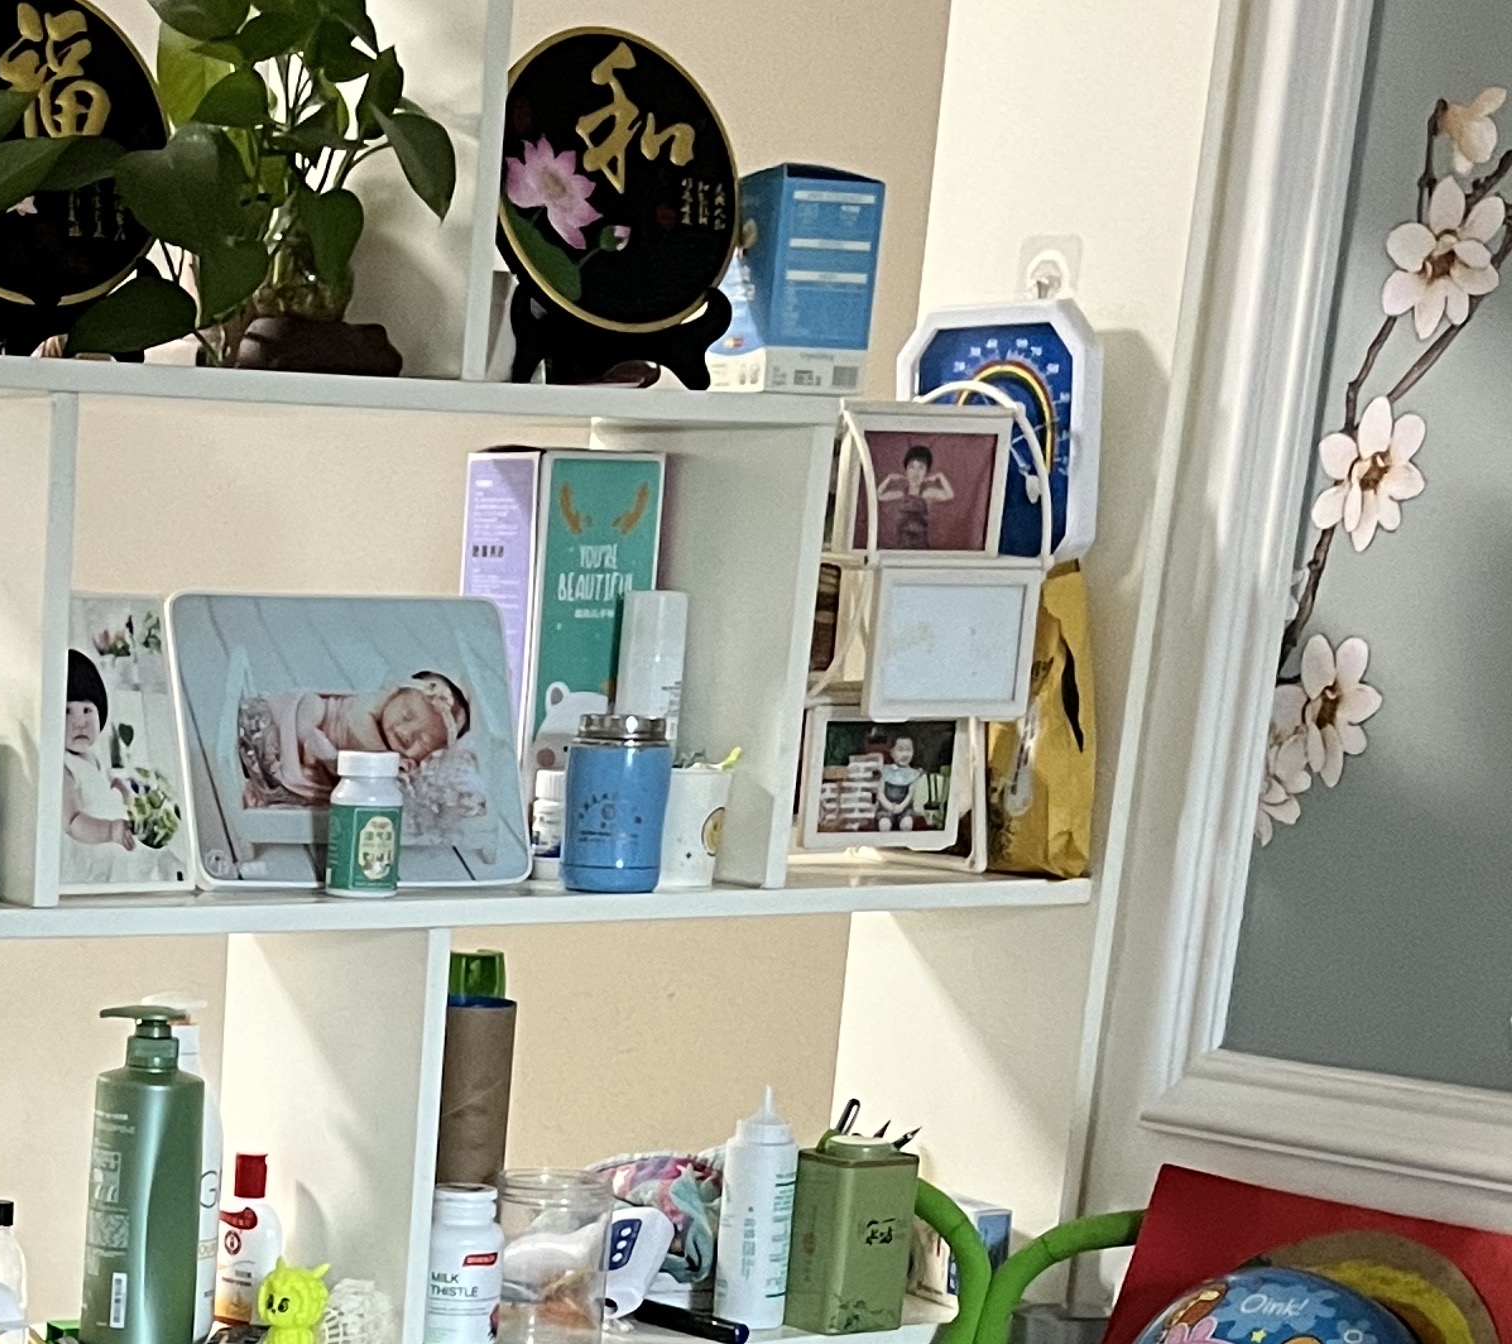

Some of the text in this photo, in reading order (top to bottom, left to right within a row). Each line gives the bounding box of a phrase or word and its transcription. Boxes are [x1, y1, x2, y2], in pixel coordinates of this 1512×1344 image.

[575, 41, 695, 194] 和
[431, 1271, 460, 1283] MILK
[430, 1284, 479, 1297] THISTLE
[1240, 1293, 1309, 1317] Oink!
